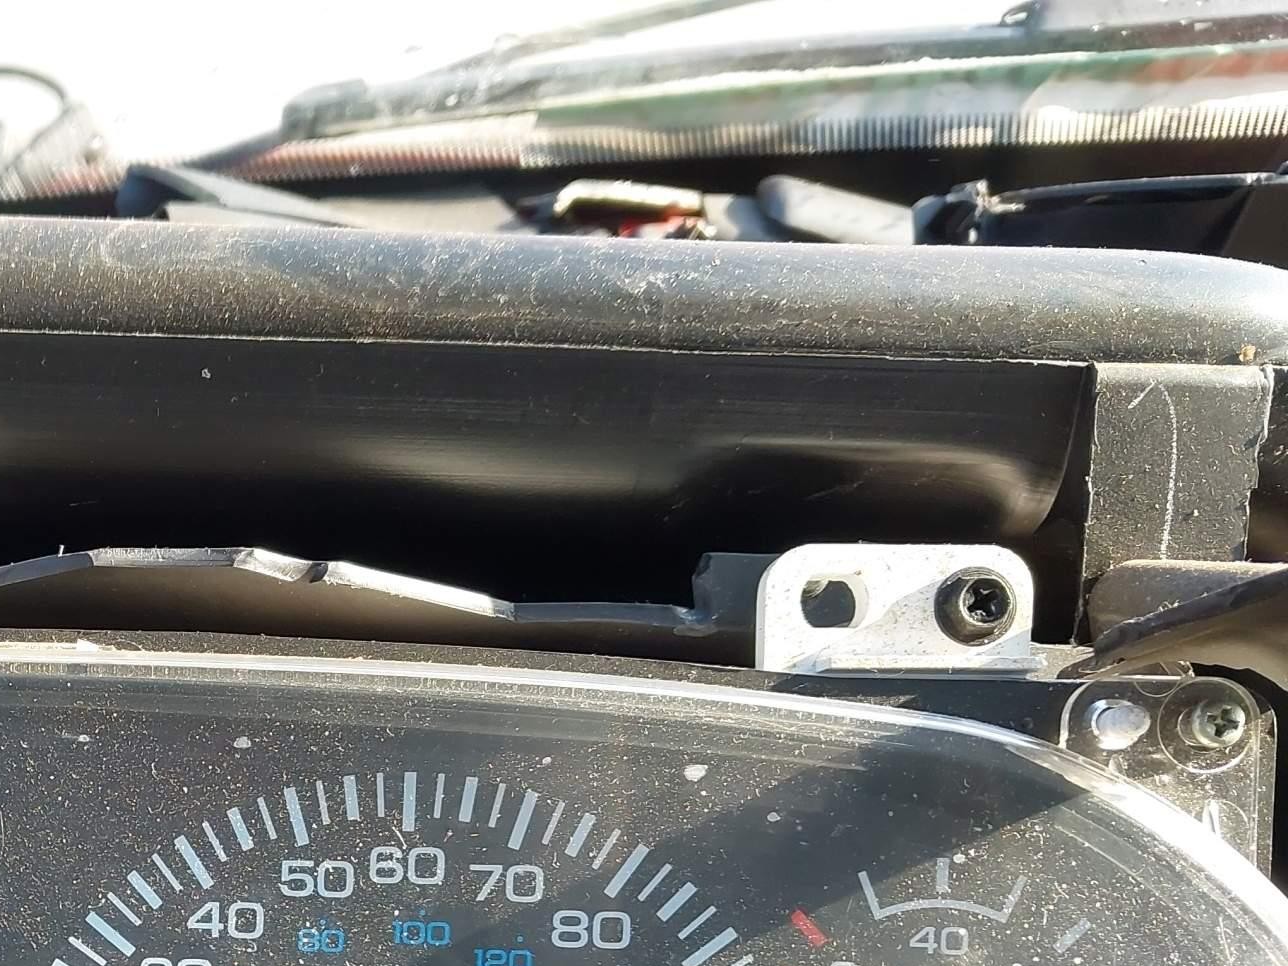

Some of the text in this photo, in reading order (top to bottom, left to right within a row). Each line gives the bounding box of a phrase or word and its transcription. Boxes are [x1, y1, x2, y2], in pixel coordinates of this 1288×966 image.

[280, 860, 354, 898] 50
[368, 846, 446, 885] 60
[469, 864, 545, 903] 70
[187, 902, 264, 939] 40
[393, 921, 451, 946] 100
[551, 910, 632, 950] 80
[909, 926, 969, 956] 40
